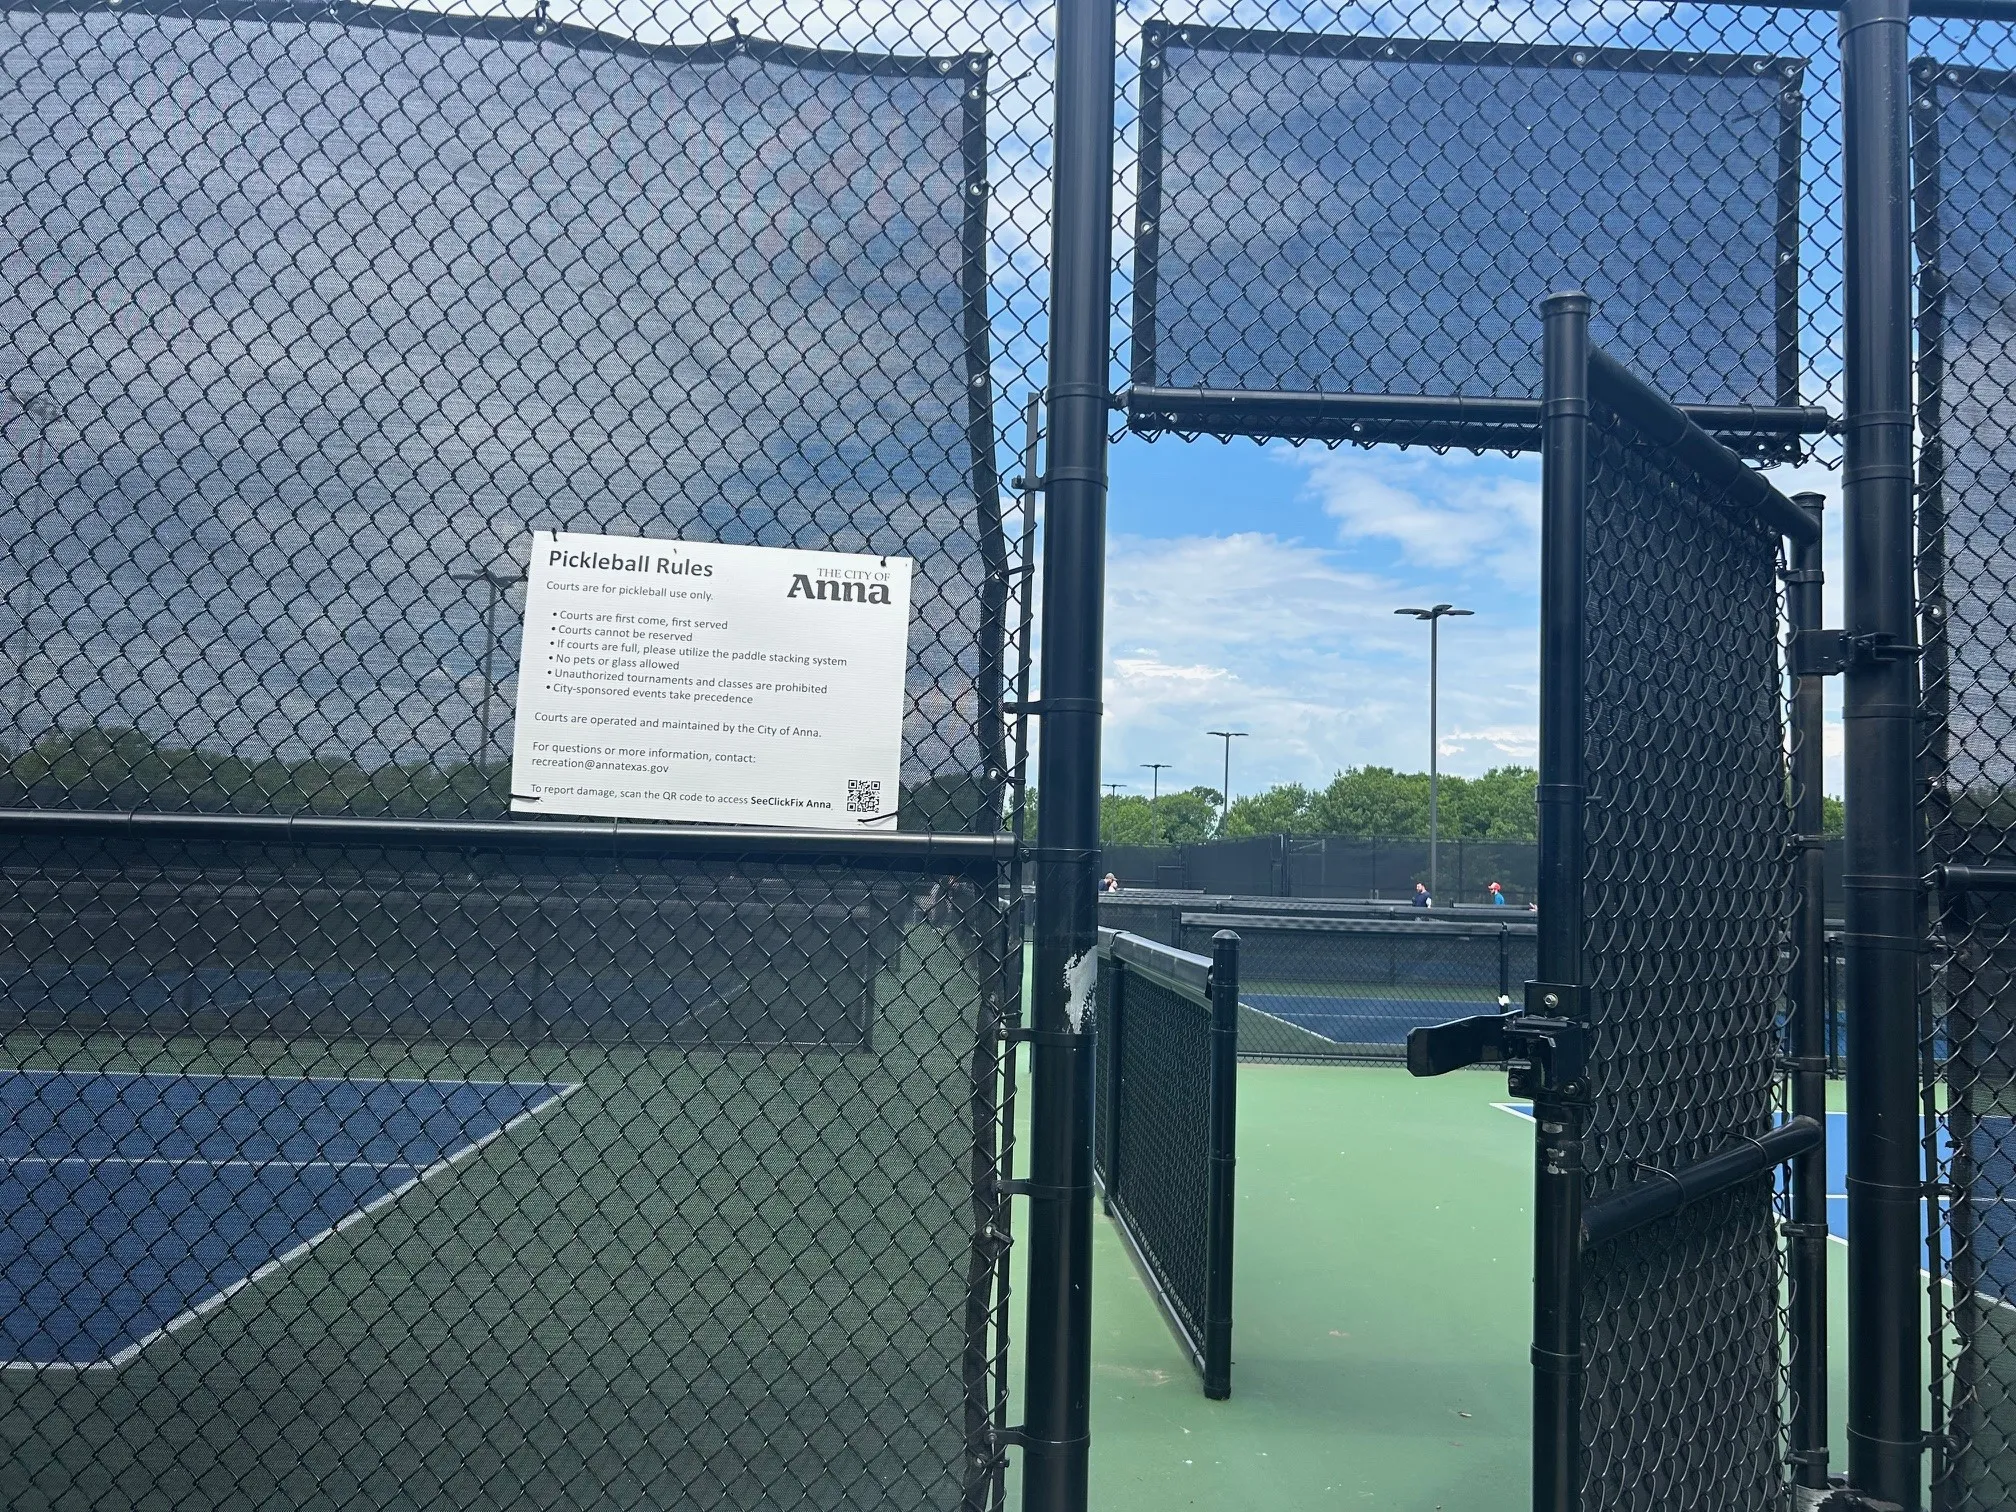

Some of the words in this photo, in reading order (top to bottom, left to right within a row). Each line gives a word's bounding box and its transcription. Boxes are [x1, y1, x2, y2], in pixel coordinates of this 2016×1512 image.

[549, 550, 650, 573] Pickleball
[656, 557, 714, 577] Rules
[816, 568, 842, 579] THE
[844, 569, 872, 581] CITY
[874, 572, 891, 582] OF
[546, 581, 580, 592] Courts
[582, 584, 599, 593] are
[601, 584, 617, 594] for
[618, 586, 667, 597] pickleball
[669, 590, 687, 599] use
[689, 591, 714, 602] only.
[786, 573, 892, 605] Anna
[559, 610, 594, 621] Courts
[596, 614, 613, 622] are
[615, 613, 635, 624] first
[637, 616, 669, 627] come,
[671, 617, 692, 627] first
[694, 620, 729, 630] served
[558, 625, 592, 636] Courts
[594, 628, 629, 638] cannot
[632, 630, 646, 639] be
[648, 631, 693, 642] reserved
[556, 654, 571, 664] No
[573, 656, 595, 666] pets
[597, 658, 610, 666] or
[611, 658, 637, 669] glass
[639, 659, 680, 670] allowed
[557, 639, 565, 648] If
[566, 641, 600, 650] courts
[601, 643, 618, 652] are
[621, 643, 640, 654] full,
[643, 645, 676, 656] please
[679, 647, 710, 657] utilize
[712, 648, 729, 659] the
[731, 651, 767, 661] paddle
[769, 653, 810, 665] stacking
[812, 656, 847, 667] system
[554, 669, 624, 681] Unauthorized
[627, 672, 693, 686] tournaments
[695, 676, 715, 687] and
[717, 678, 753, 689] classes
[755, 682, 772, 691] are
[774, 683, 828, 694] prohibited
[553, 683, 630, 697] City-sponsored
[632, 689, 667, 699] events
[669, 690, 691, 701] take
[693, 692, 754, 704] precedence
[534, 712, 568, 723] Courts
[570, 715, 588, 724] are
[590, 716, 637, 727] operated
[639, 718, 659, 728] and
[661, 719, 720, 732] maintained
[722, 723, 735, 733] by
[737, 724, 755, 733] the
[757, 725, 777, 737] City
[779, 726, 791, 735] of
[792, 728, 822, 738] Anna.
[532, 742, 550, 751] For
[552, 744, 602, 755] questions
[604, 747, 616, 755] or
[618, 748, 646, 757] more
[648, 748, 712, 762] information,
[714, 752, 757, 764] contact:
[531, 757, 669, 775] recreation@annatexas.gov
[531, 784, 542, 793] To
[544, 785, 574, 796] report
[576, 786, 618, 798] damage,
[620, 789, 642, 798] scan
[644, 789, 660, 800] the
[662, 791, 677, 801] QR
[679, 793, 703, 802] code
[705, 794, 716, 803] to
[717, 795, 748, 805] access
[750, 796, 804, 808] SeeClickFix
